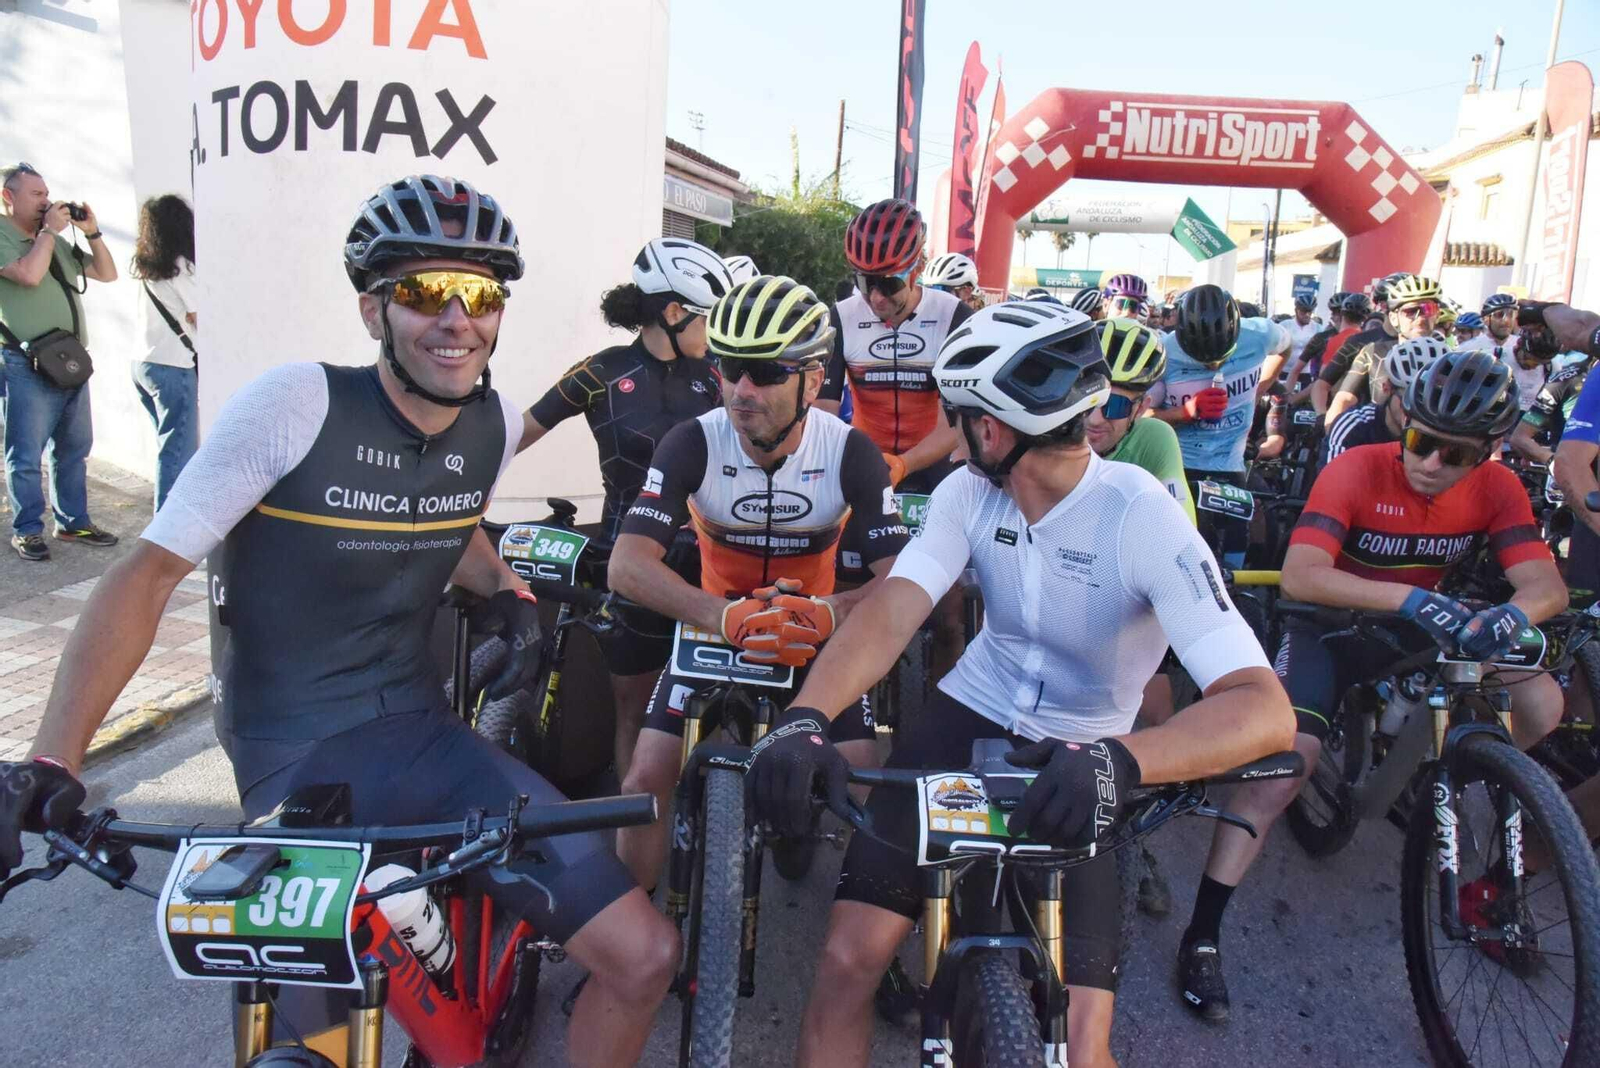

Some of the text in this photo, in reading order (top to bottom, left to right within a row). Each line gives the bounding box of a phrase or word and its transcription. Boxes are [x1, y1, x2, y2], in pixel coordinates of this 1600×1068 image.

[212, 80, 498, 166] TOMAX
[1123, 108, 1321, 166] NutriSport
[674, 185, 684, 207] EL
[685, 189, 707, 213] PASO
[1102, 215, 1142, 223] CICLISMO
[876, 343, 918, 351] SYMISUR
[939, 378, 981, 388] SCOTT
[356, 444, 400, 469] GOBIK
[325, 486, 482, 514] CLINICA ROMERO
[741, 502, 801, 514] SYMISUR
[534, 538, 575, 560] 349
[1358, 532, 1473, 556] CONIL RACING
[1420, 602, 1463, 635] FOX
[1492, 612, 1517, 641] FOX
[249, 875, 341, 928] 397
[988, 938, 1001, 946] 34
